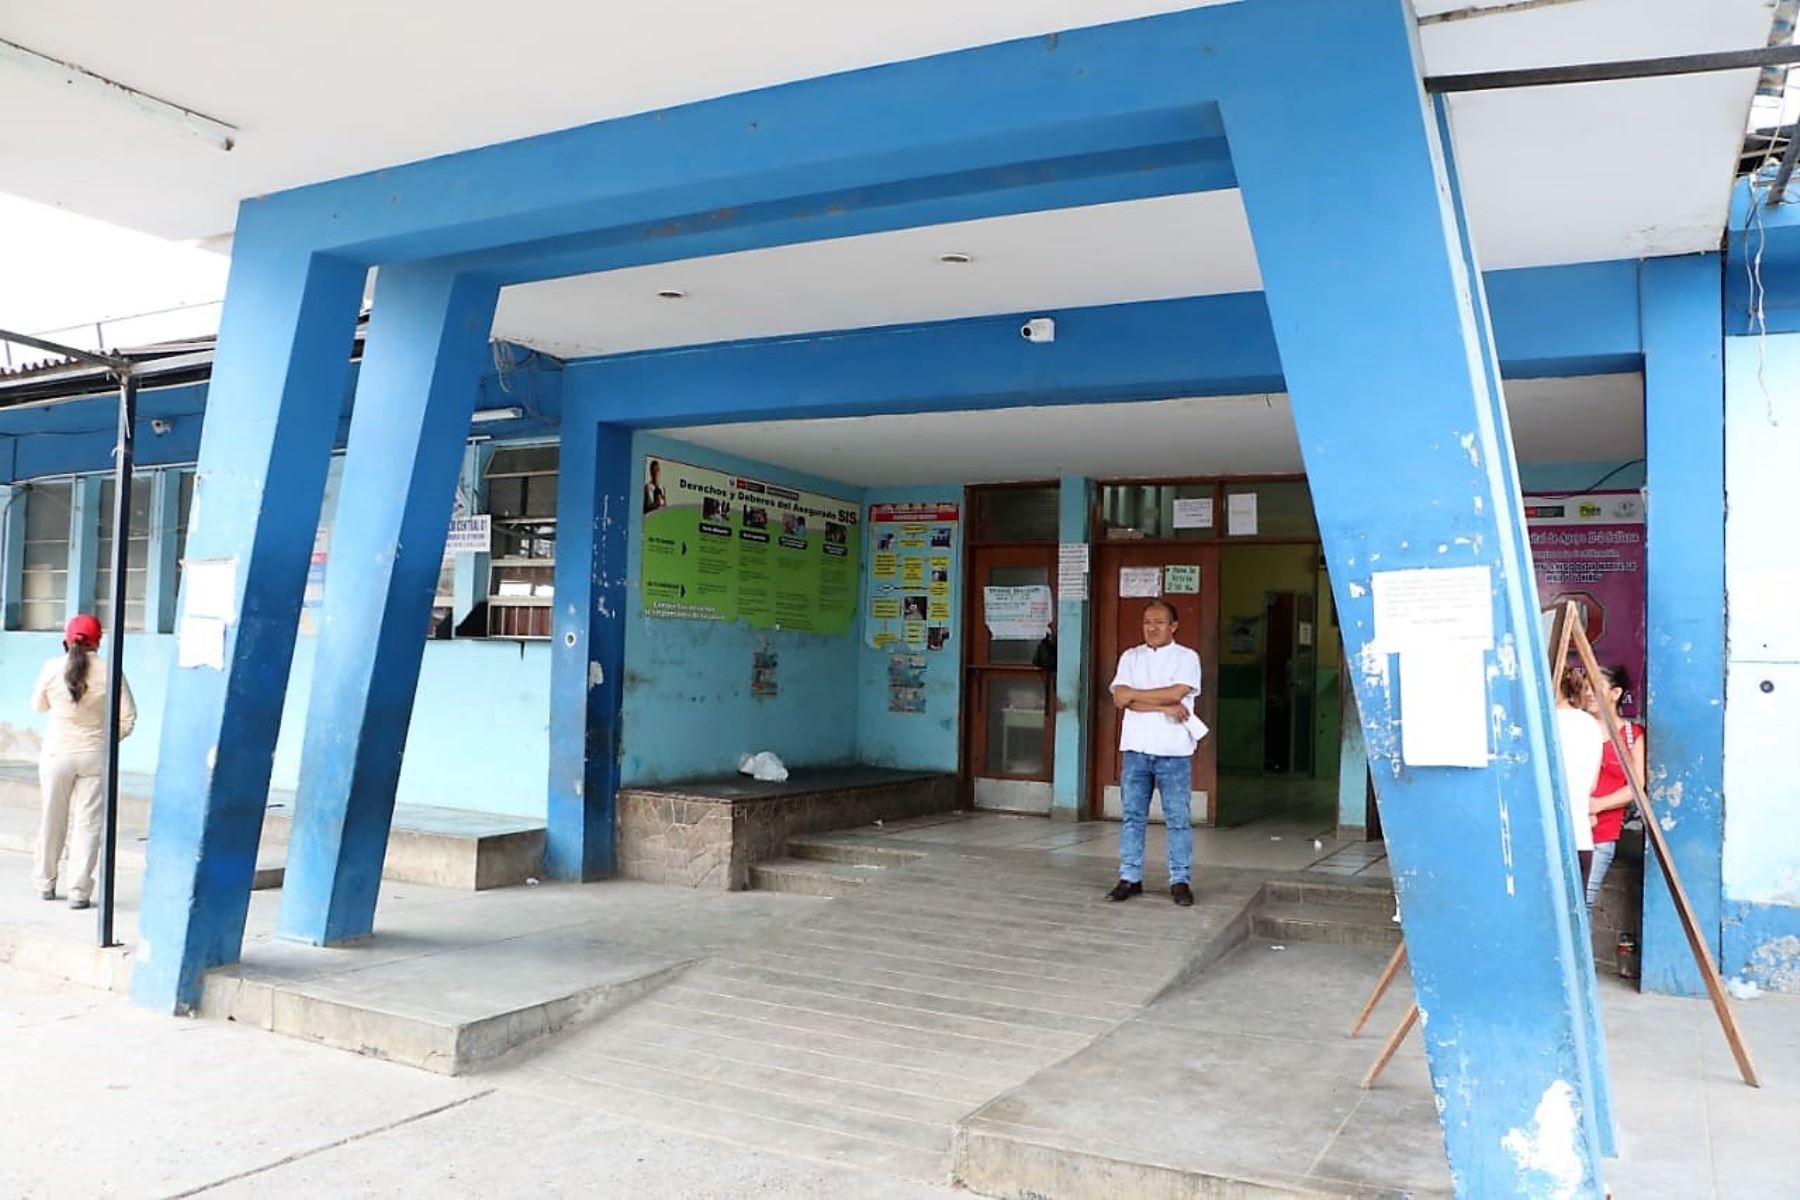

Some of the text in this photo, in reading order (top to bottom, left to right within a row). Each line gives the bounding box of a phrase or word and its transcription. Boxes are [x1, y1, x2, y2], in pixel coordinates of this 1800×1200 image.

[679, 478, 727, 497] Derechos
[729, 491, 736, 500] y
[737, 491, 776, 507] Deberes
[777, 499, 791, 510] del
[793, 503, 837, 519] Asegurado
[837, 508, 858, 525] SIS
